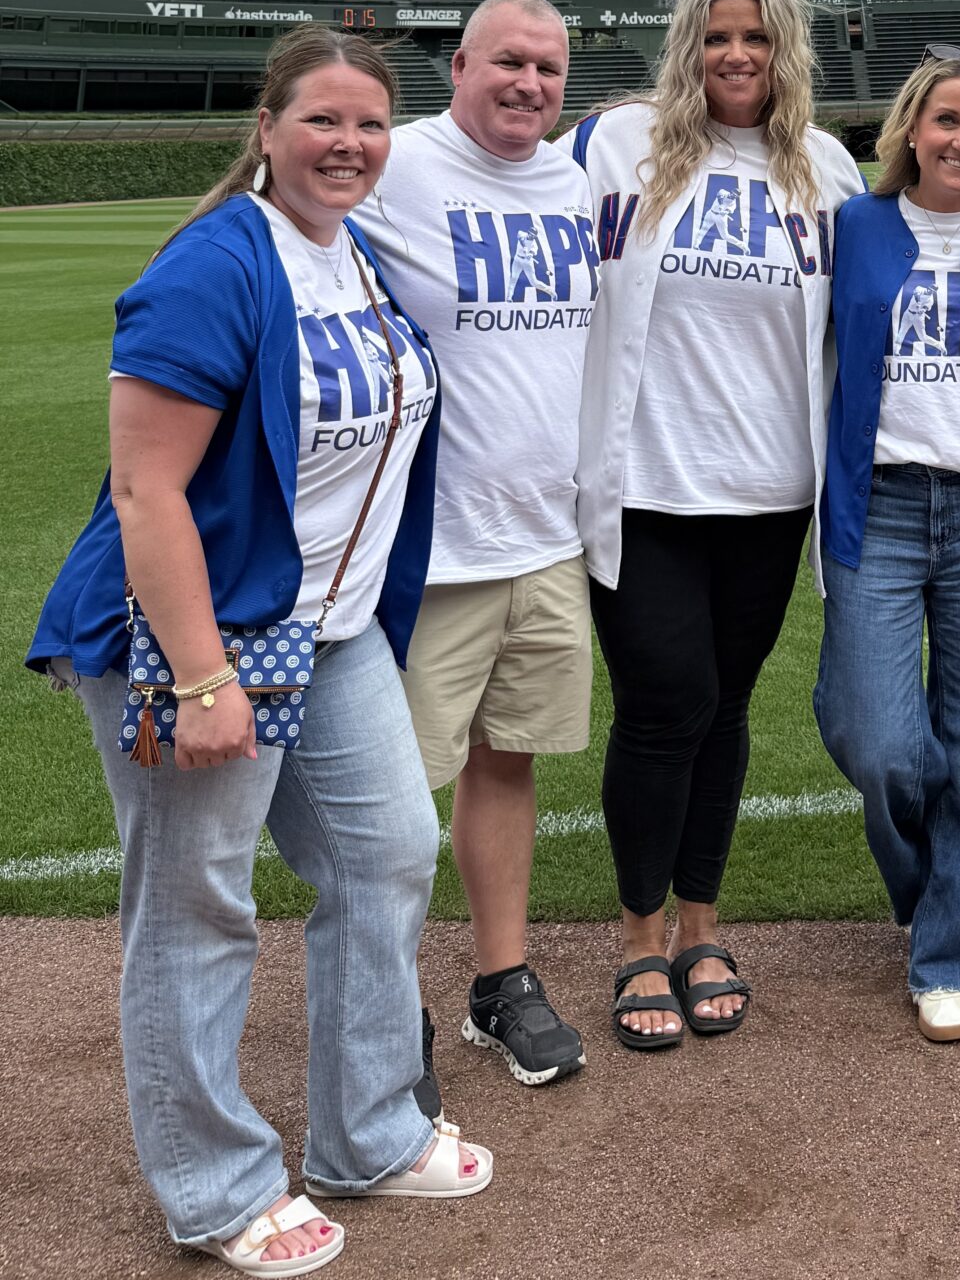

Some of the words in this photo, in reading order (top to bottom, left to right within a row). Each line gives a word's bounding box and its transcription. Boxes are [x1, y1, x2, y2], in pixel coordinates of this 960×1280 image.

[396, 9, 462, 21] GRAINGER
[619, 11, 673, 24] Advocat
[673, 174, 782, 258] AP
[446, 209, 600, 303] HAPP
[660, 254, 802, 288] OUNDATI
[455, 308, 592, 331] FOUNDATI
